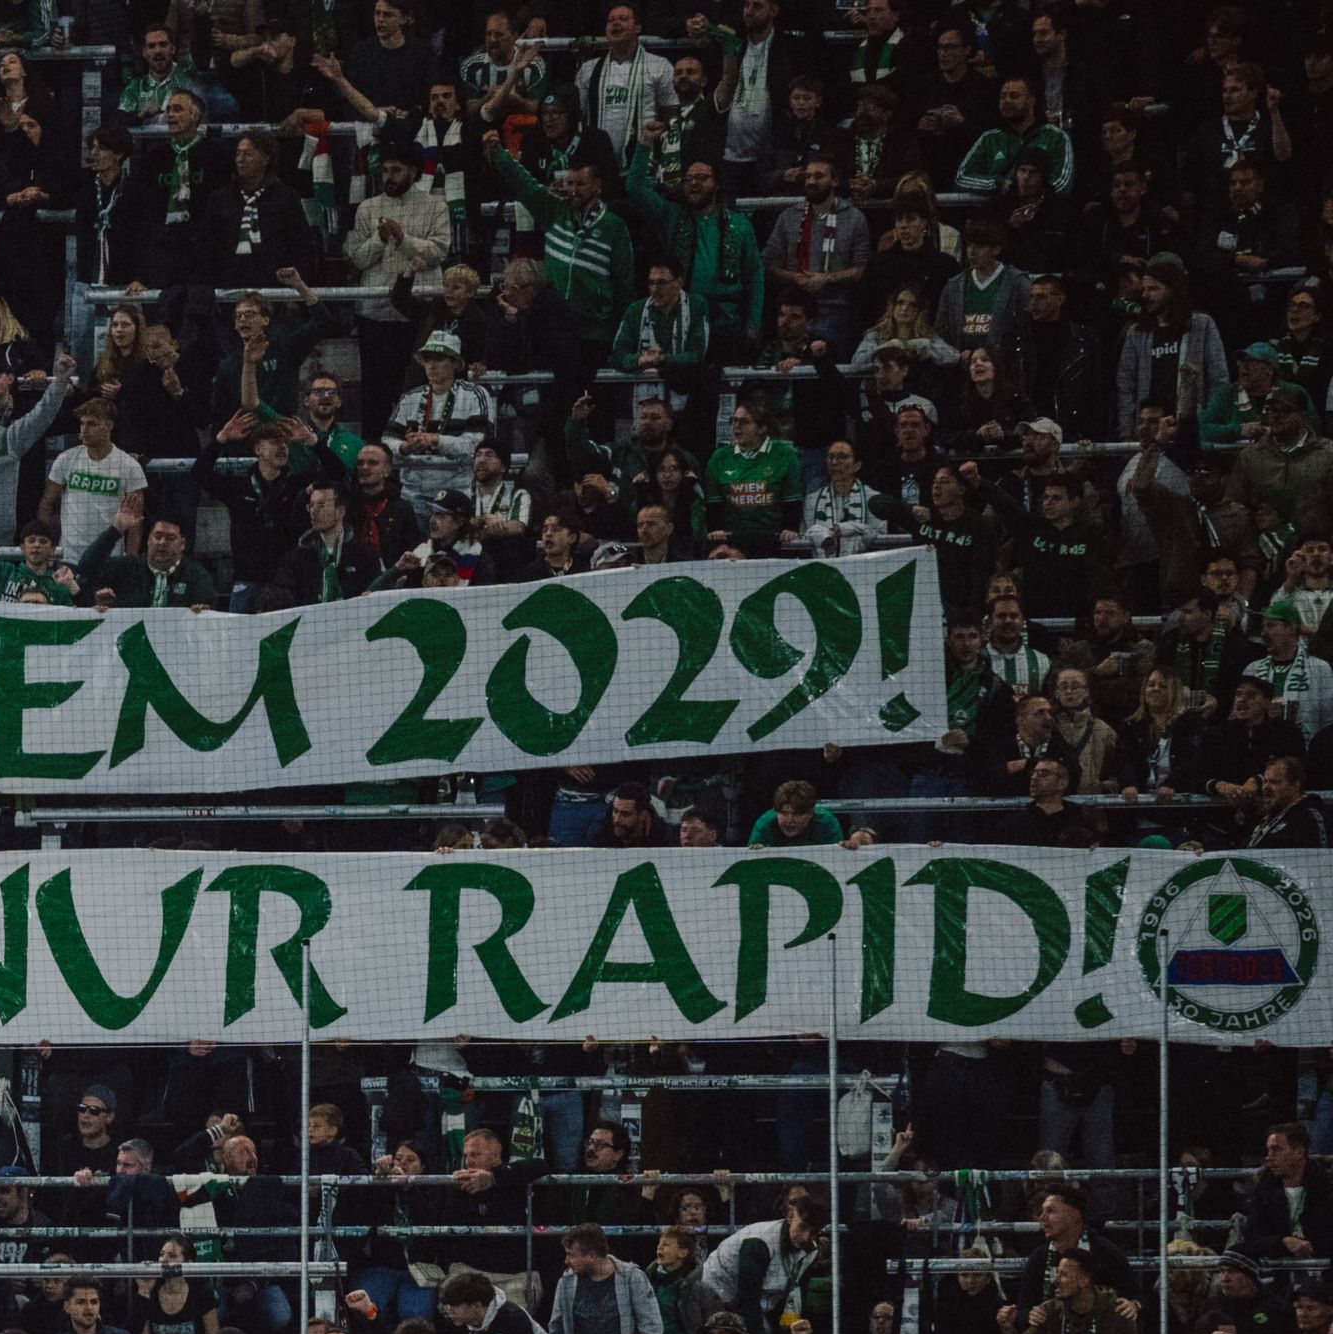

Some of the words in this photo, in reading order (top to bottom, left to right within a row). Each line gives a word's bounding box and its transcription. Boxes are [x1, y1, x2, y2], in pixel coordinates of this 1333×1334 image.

[69, 474, 118, 492] RAPID
[733, 483, 765, 492] WIEN
[918, 525, 973, 547] ULTRAS
[366, 560, 919, 765] 2029!
[1140, 881, 1180, 941] 1996
[1274, 878, 1318, 941] 2026
[405, 853, 1130, 1031] RAPID!
[1170, 993, 1200, 1019] 30
[1209, 995, 1292, 1030] JAHRE
